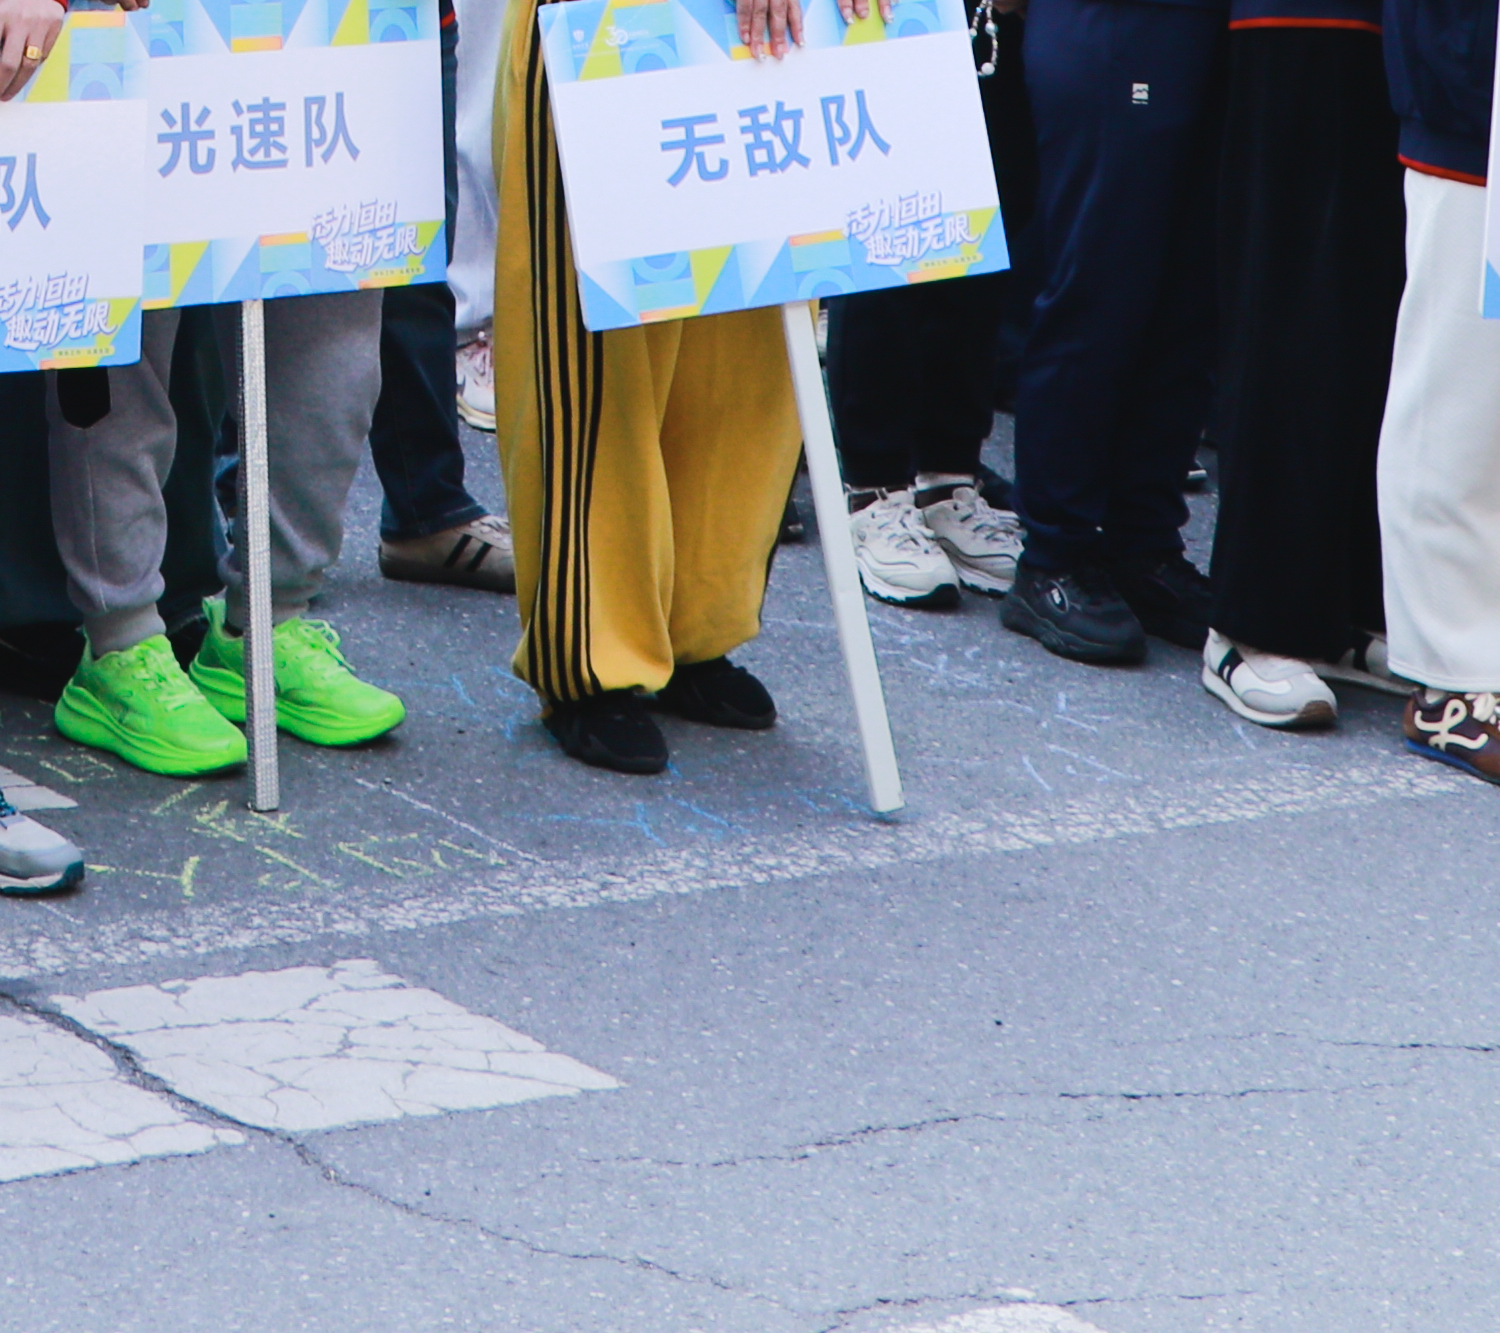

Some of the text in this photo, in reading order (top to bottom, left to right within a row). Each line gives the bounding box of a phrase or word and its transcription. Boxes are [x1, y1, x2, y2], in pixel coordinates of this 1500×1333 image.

[158, 91, 360, 176] 光速队
[660, 88, 891, 187] 无敌队
[3, 300, 120, 352] 趣动无限
